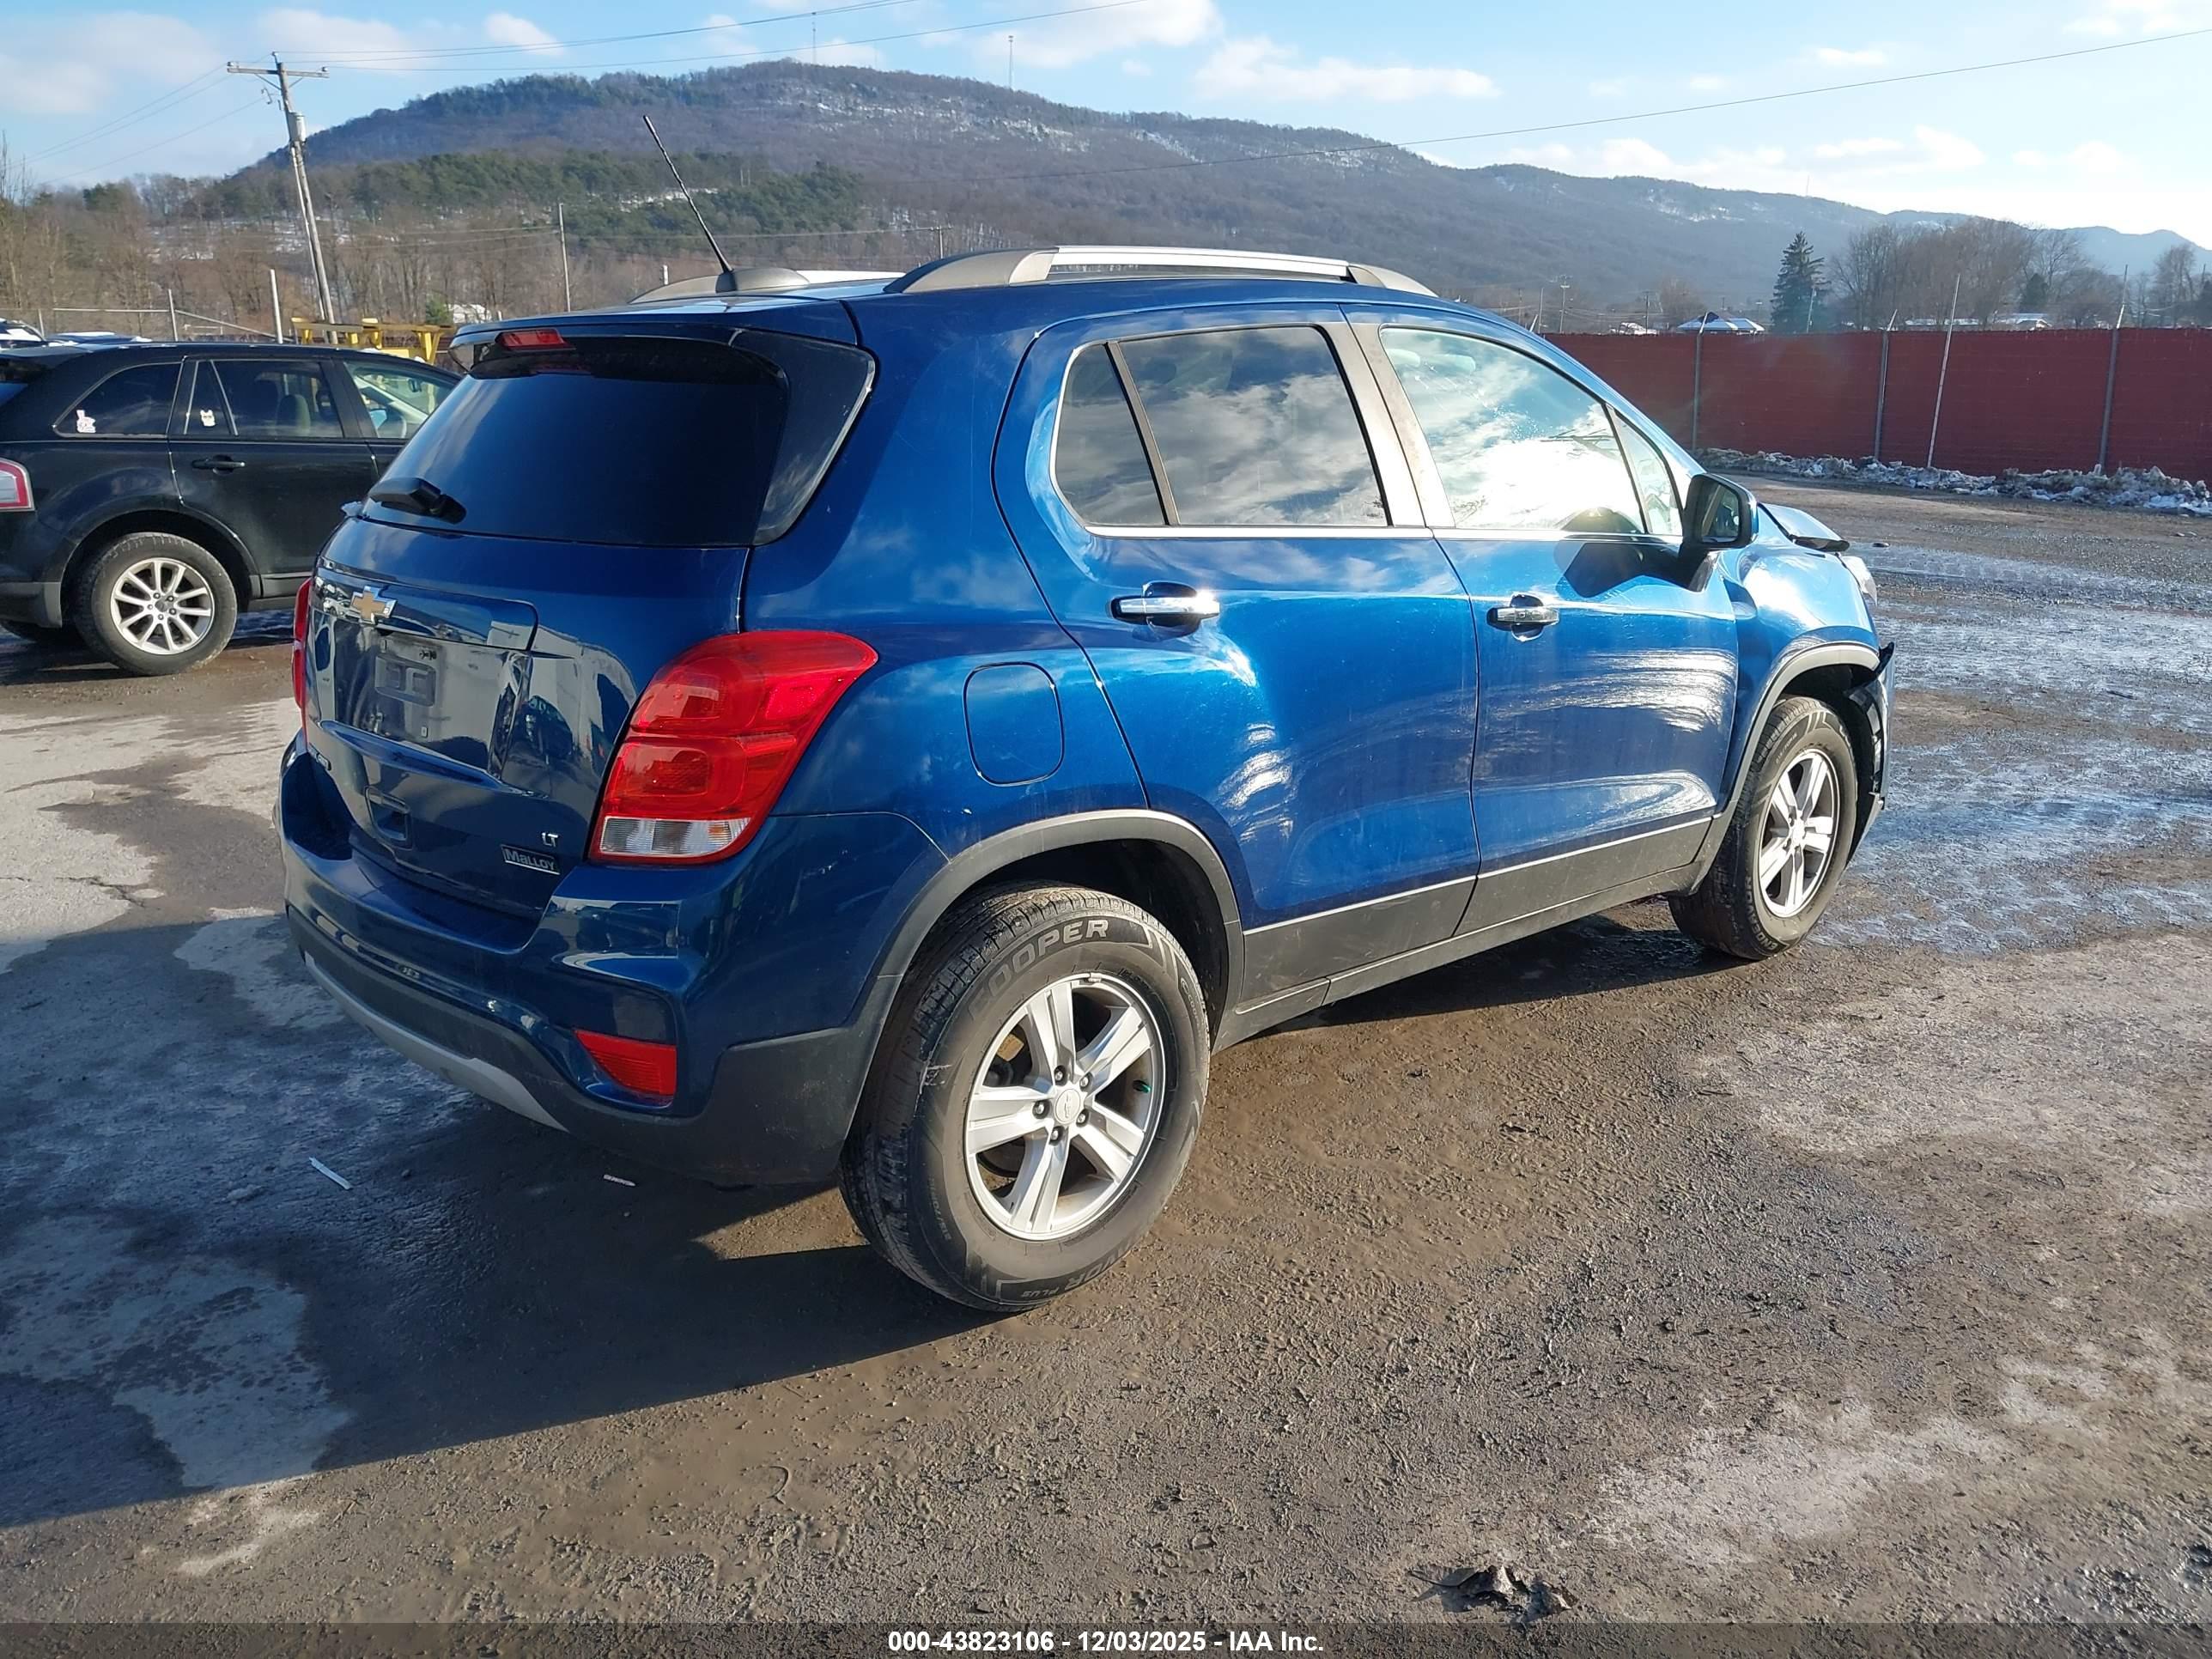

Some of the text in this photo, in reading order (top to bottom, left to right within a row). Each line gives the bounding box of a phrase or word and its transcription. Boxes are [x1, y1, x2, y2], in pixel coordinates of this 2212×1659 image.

[541, 831, 559, 848] LT
[967, 918, 1110, 1022] COOPER
[1020, 1286, 1061, 1298] PLUS
